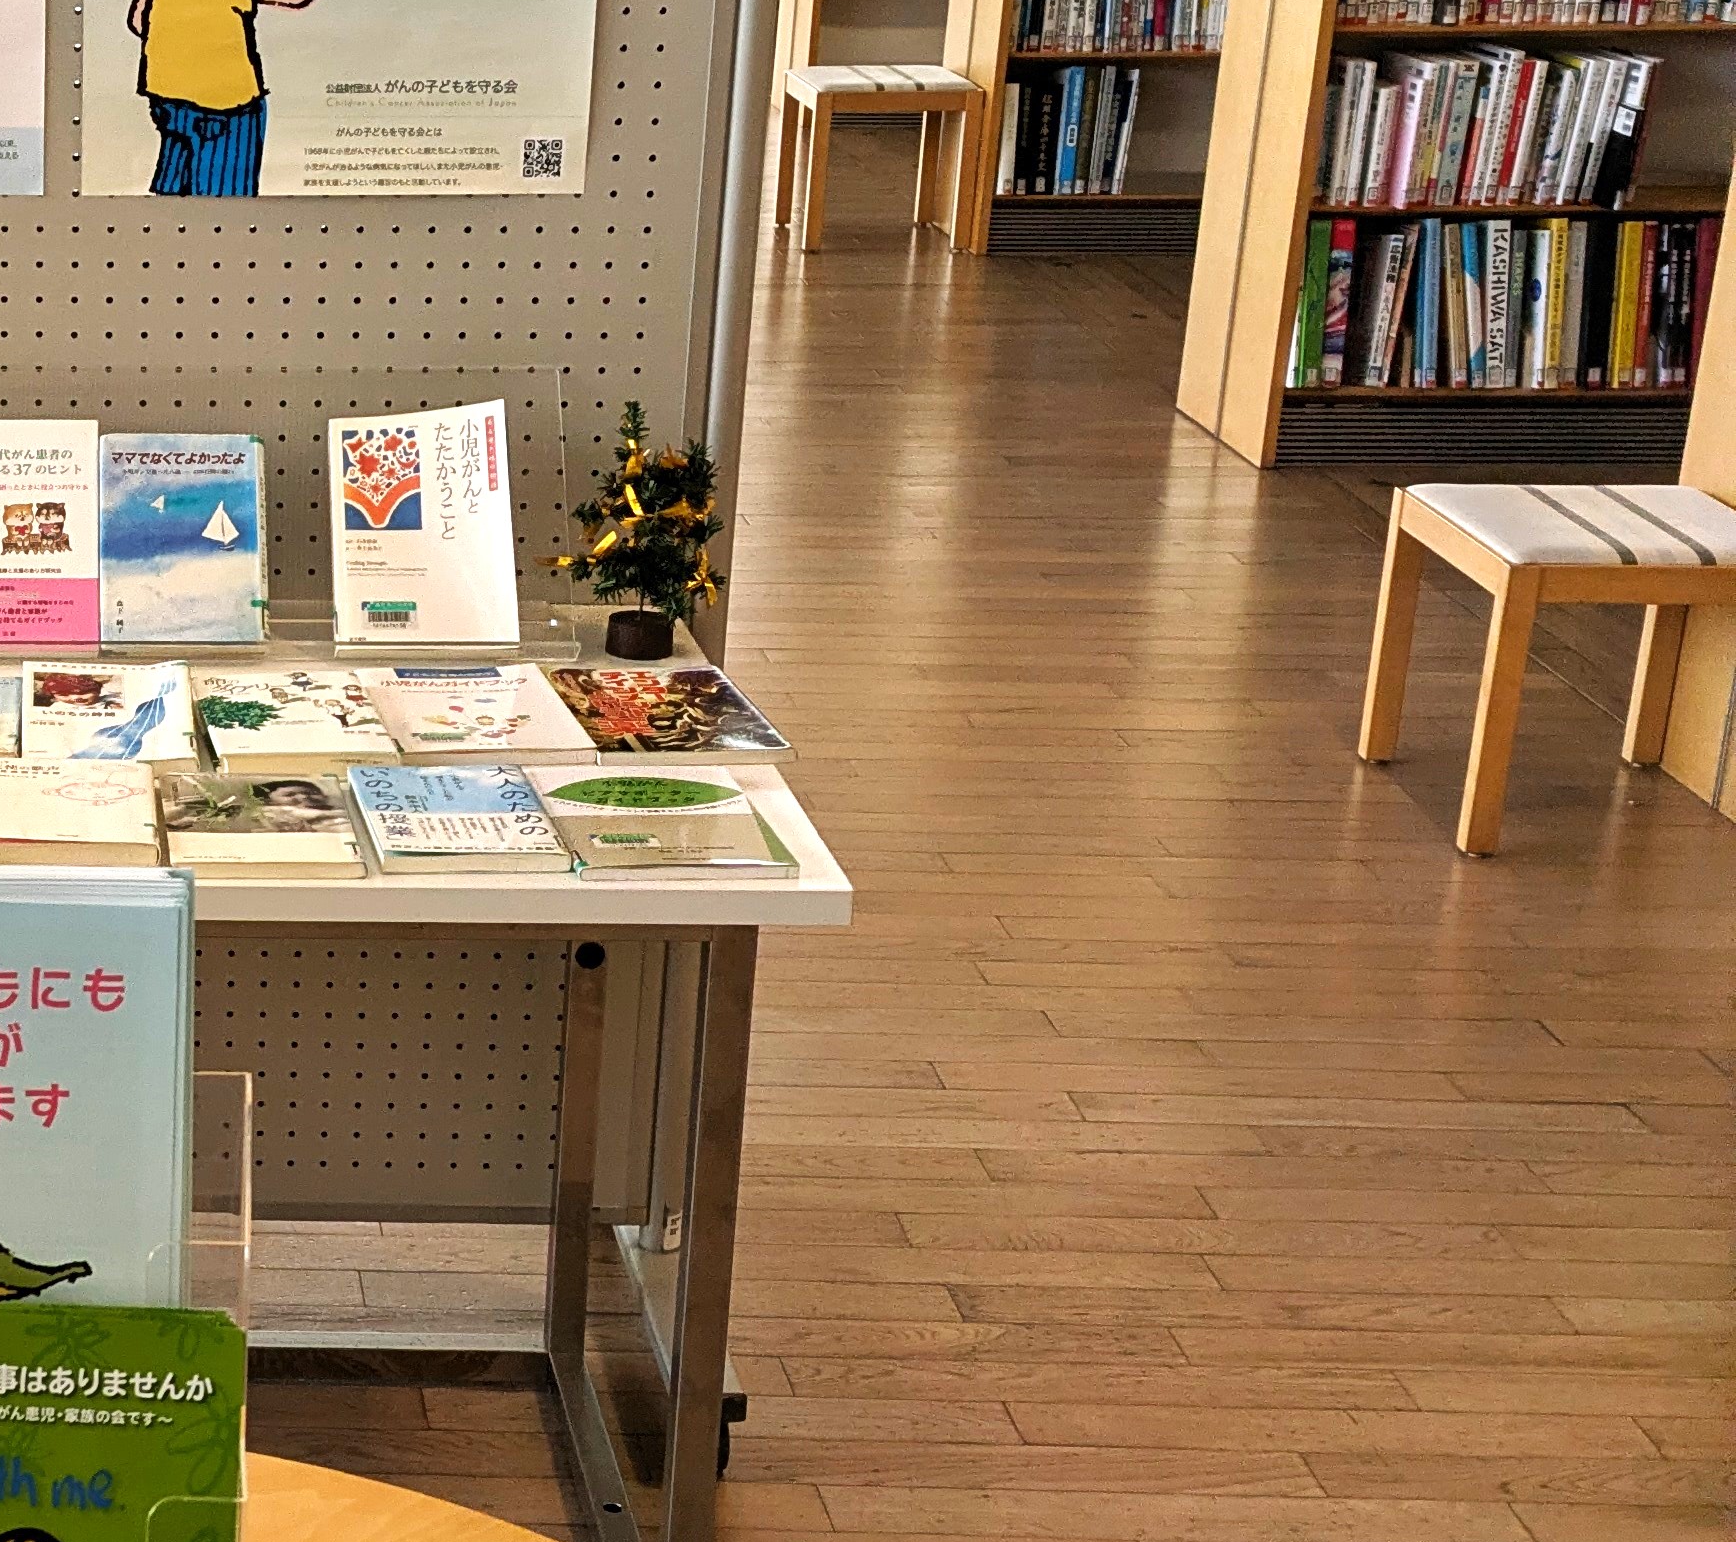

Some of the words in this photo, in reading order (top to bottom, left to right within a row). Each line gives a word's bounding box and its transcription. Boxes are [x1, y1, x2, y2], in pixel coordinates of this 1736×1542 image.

[384, 79, 518, 94] がんの子どもを守る会
[336, 127, 442, 137] がんの子どもを守る会とは
[112, 452, 246, 465] ママでなくてよかったよ
[460, 419, 482, 514] 小児がんと
[434, 422, 456, 540] たたかうこと
